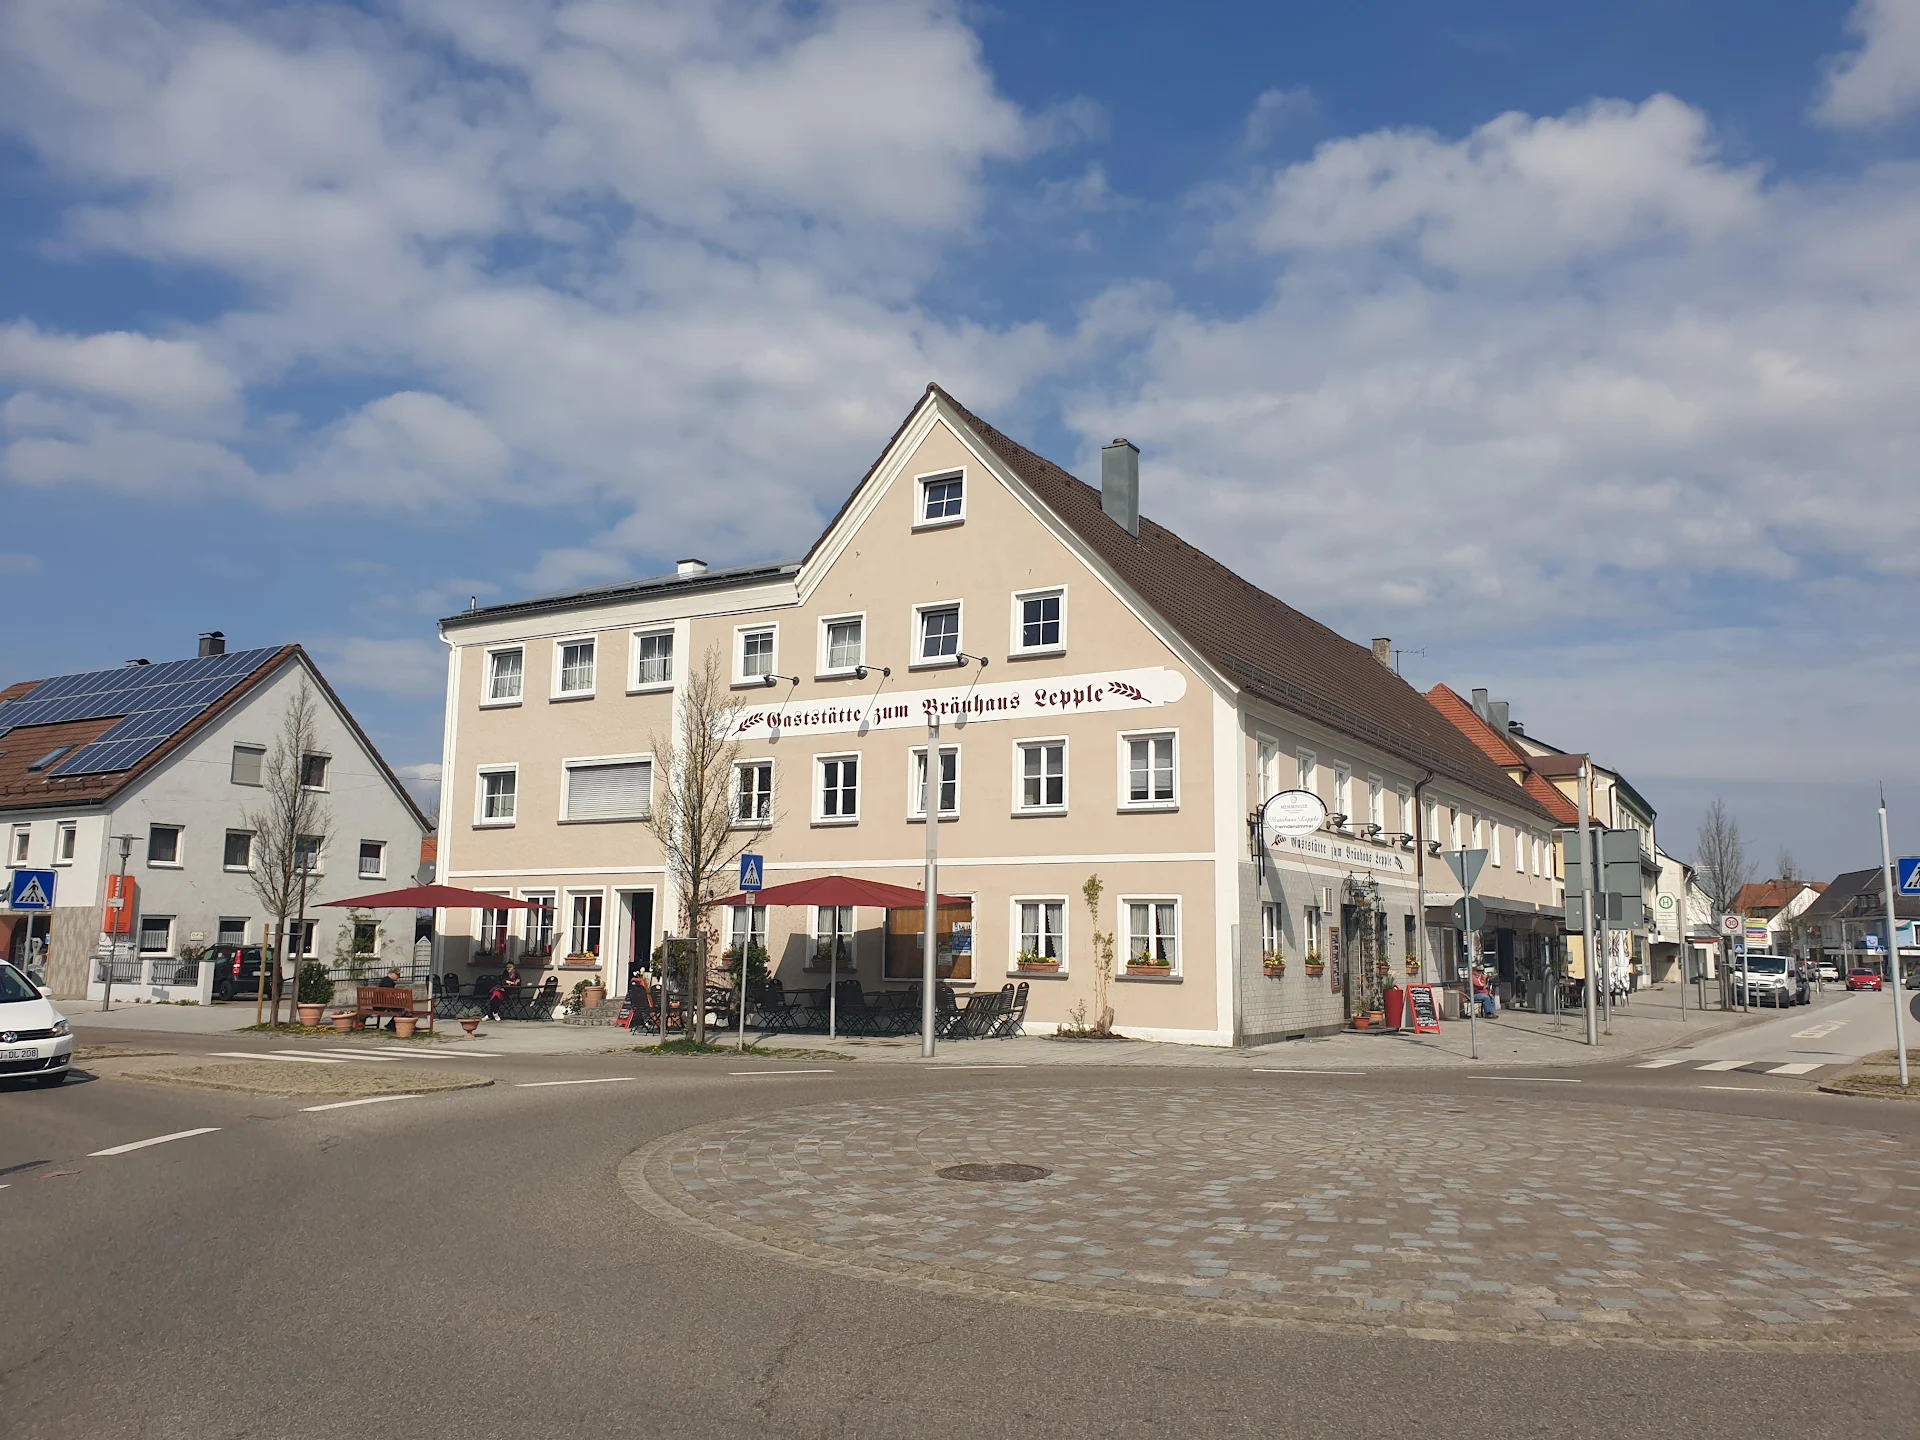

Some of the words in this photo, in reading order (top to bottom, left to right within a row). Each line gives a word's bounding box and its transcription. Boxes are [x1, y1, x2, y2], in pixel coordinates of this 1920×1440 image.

[766, 706, 862, 728] Gaststätte
[873, 704, 909, 726] zum
[922, 691, 1021, 718] Bräuhaus
[1034, 684, 1104, 710] Lepple
